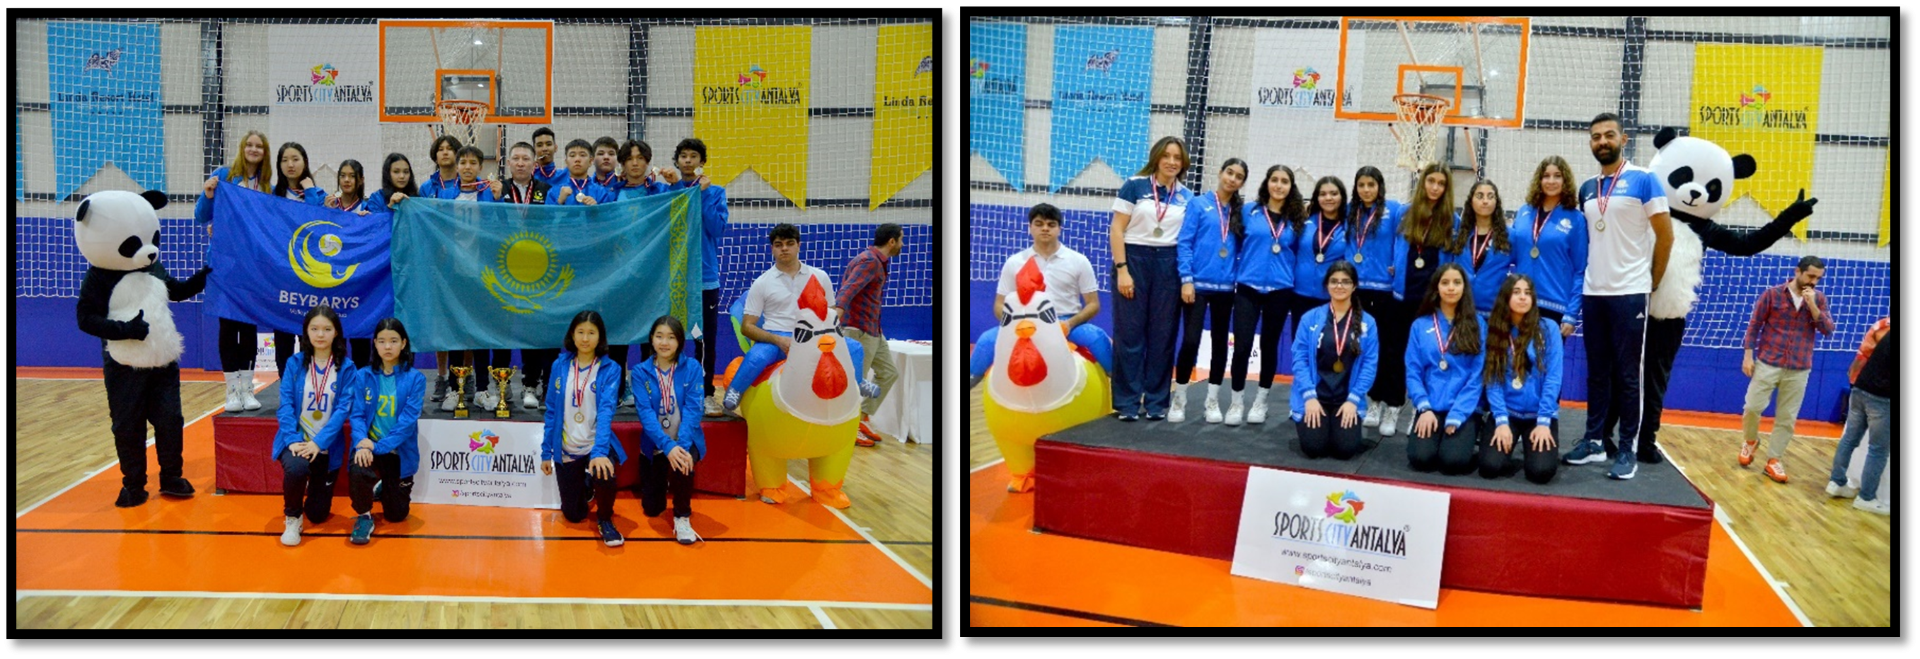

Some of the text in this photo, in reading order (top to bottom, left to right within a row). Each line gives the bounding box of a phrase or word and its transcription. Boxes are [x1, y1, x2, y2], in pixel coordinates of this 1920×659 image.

[58, 92, 88, 102] Linda
[127, 92, 154, 102] Hotel
[883, 95, 915, 107] Linda
[279, 290, 359, 309] BEYBARYS
[307, 392, 329, 412] 20
[377, 395, 395, 417] 21
[1281, 549, 1393, 574] www.sportscityantalya.com
